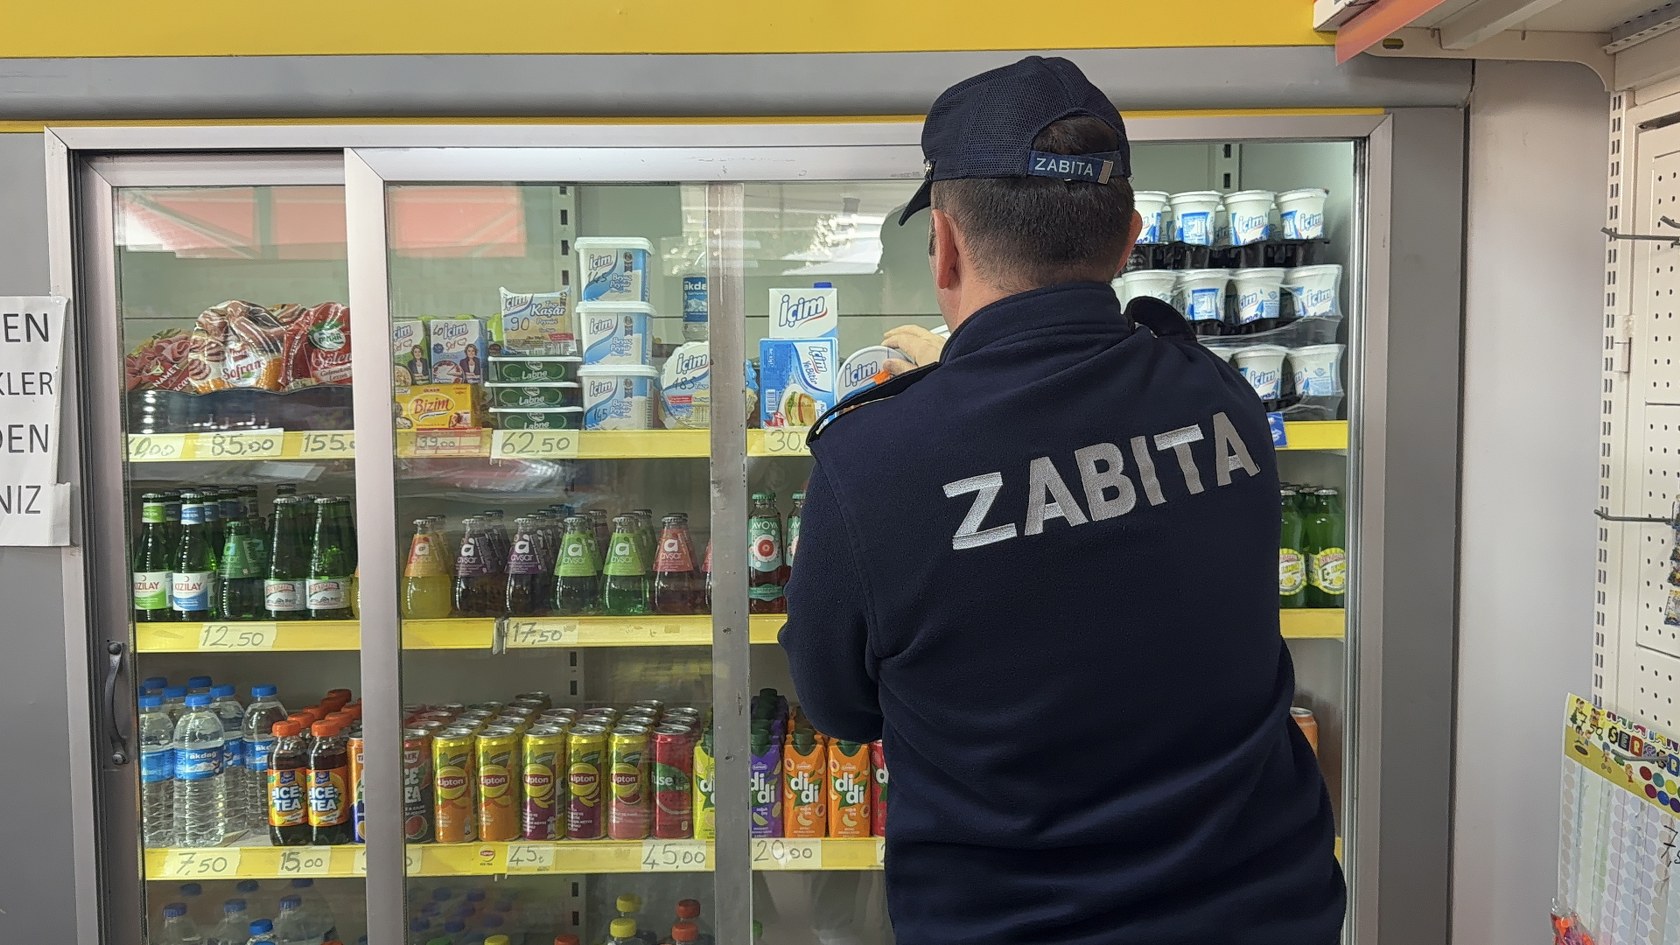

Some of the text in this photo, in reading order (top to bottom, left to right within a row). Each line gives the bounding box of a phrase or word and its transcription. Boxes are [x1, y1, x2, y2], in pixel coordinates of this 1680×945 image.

[1035, 157, 1093, 177] ZABITA
[530, 303, 566, 317] Kaşar
[779, 294, 826, 328] İçim
[3, 313, 49, 343] EN
[510, 317, 530, 331] 90
[676, 352, 708, 375] İçim
[844, 360, 878, 387] İçim
[153, 363, 180, 388] NAMET
[414, 397, 450, 414] Bizim
[0, 424, 49, 453] EN
[212, 434, 274, 457] 85,00
[501, 431, 570, 454] 62,50
[942, 411, 1261, 550] ZABITA
[202, 625, 264, 648] 12,50
[513, 622, 562, 645] 17,50
[275, 784, 300, 799] ICE
[311, 784, 336, 799] ICE
[790, 771, 809, 791] di
[835, 772, 854, 792] di
[404, 786, 422, 804] EA
[801, 783, 819, 804] di
[846, 784, 865, 804] di
[274, 799, 302, 812] TEA
[310, 799, 337, 812] TEA
[281, 852, 323, 873] 15,00
[642, 843, 706, 869] 45,00
[754, 840, 812, 863] 20,00
[176, 852, 228, 875] 7,50
